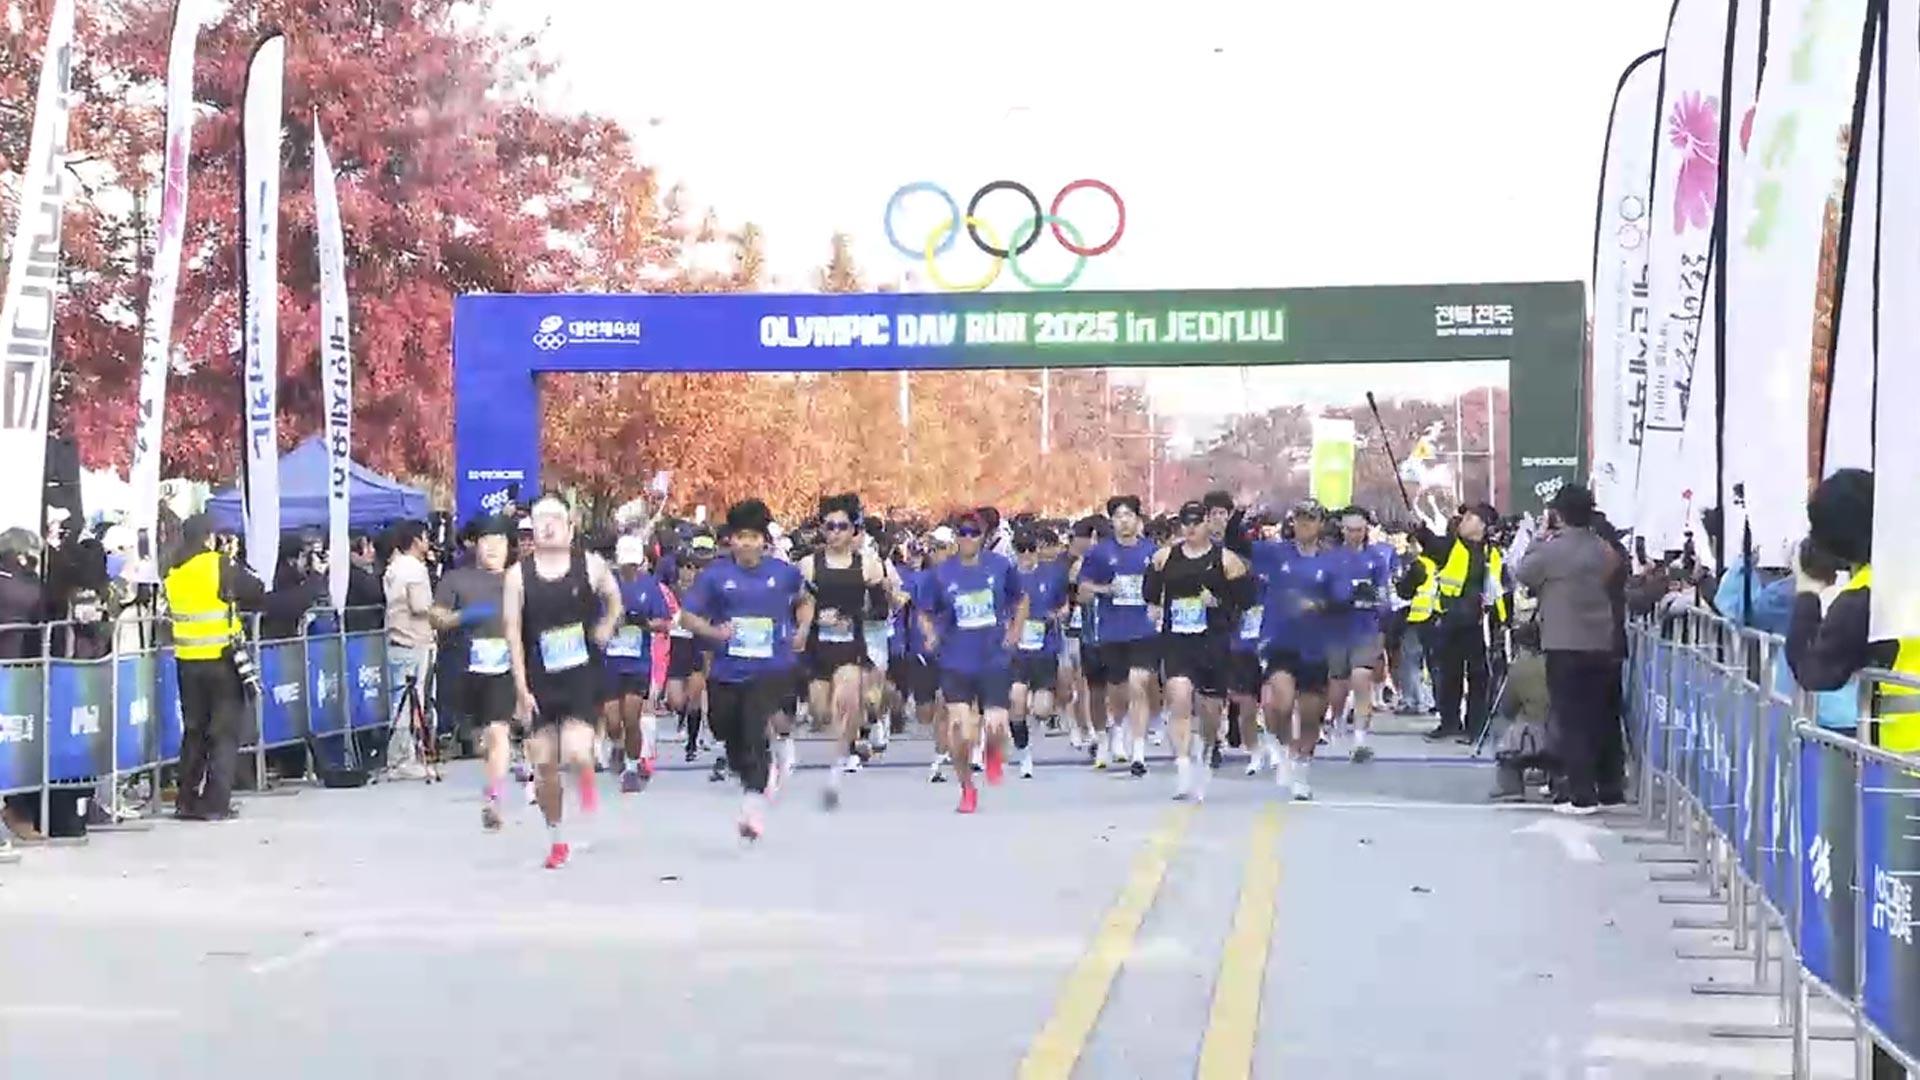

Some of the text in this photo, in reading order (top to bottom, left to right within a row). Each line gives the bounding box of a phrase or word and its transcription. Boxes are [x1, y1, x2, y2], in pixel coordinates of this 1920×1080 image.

[1475, 304, 1514, 325] 전주
[568, 320, 640, 338] 대한체육회
[760, 314, 890, 347] OLYMPIC
[896, 314, 957, 346] DAY
[964, 313, 1027, 343] RUN
[1034, 311, 1118, 343] 2025
[1162, 310, 1284, 342] JEONJU
